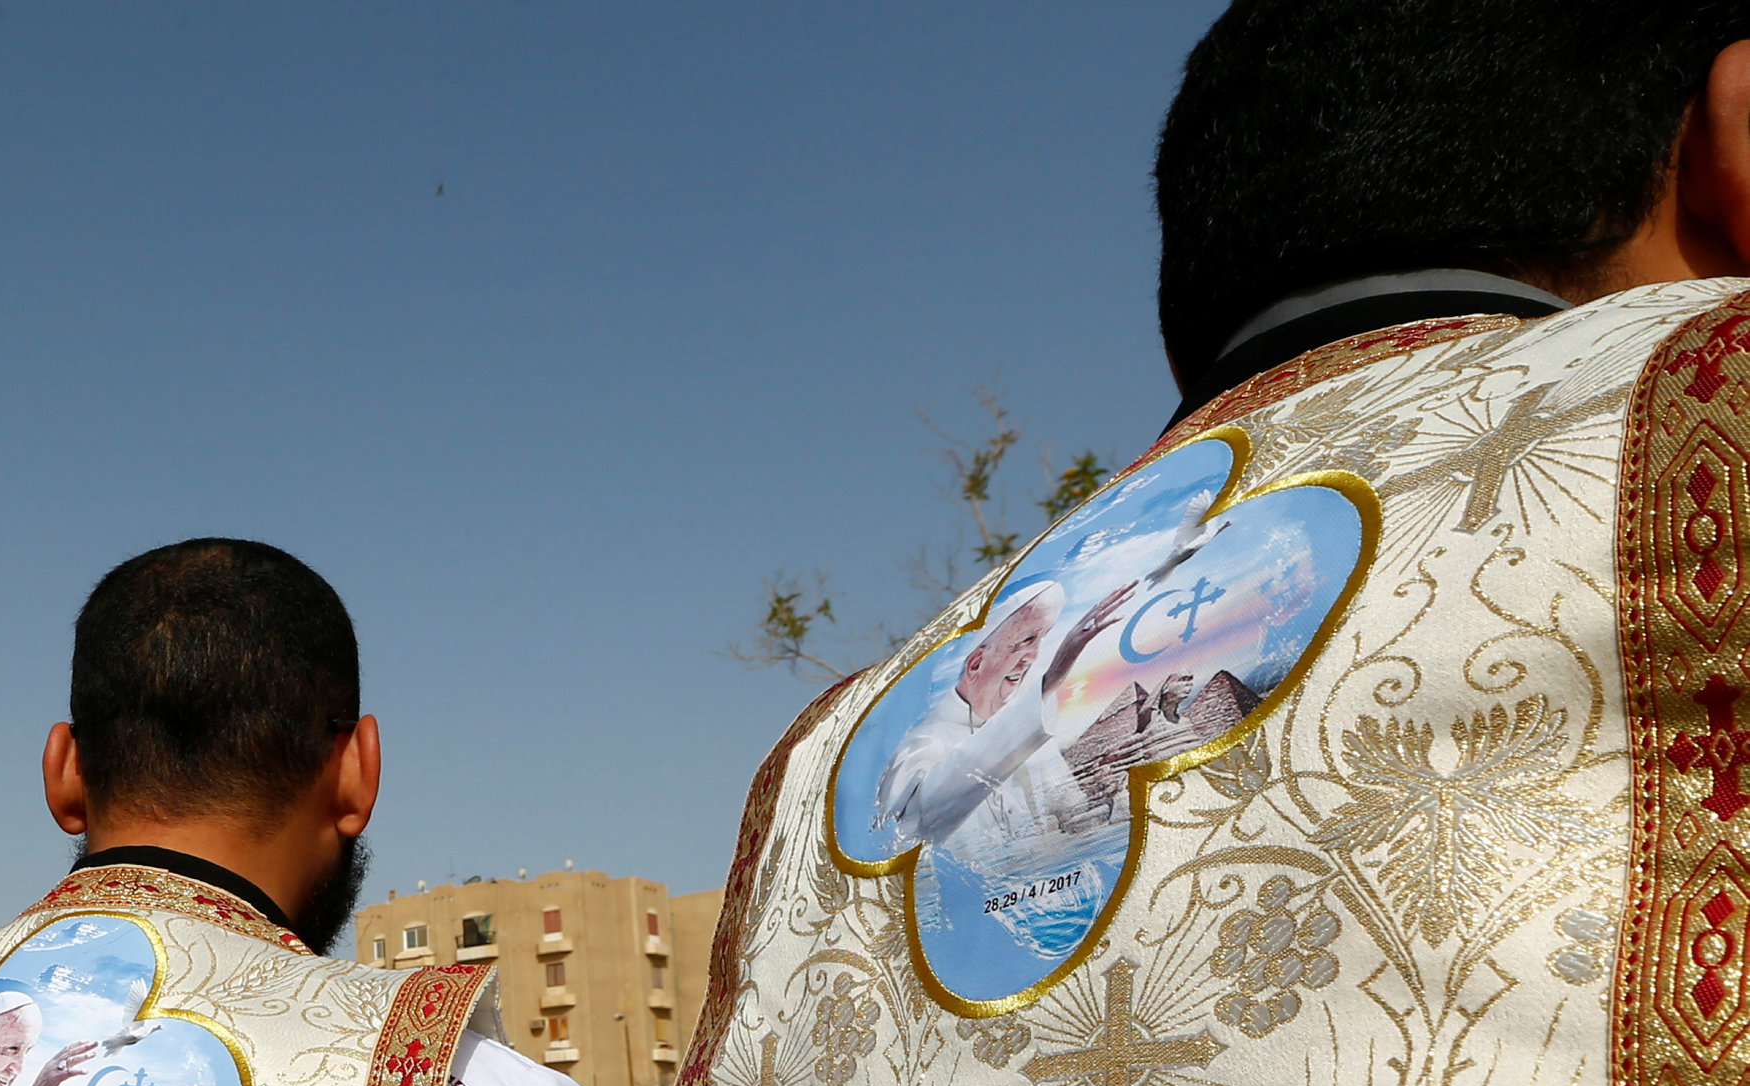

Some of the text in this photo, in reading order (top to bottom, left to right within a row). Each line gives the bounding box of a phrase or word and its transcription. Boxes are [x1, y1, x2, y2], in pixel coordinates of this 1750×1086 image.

[984, 891, 1018, 914] 28,29
[1028, 885, 1037, 899] 4
[1048, 871, 1081, 893] 2017
